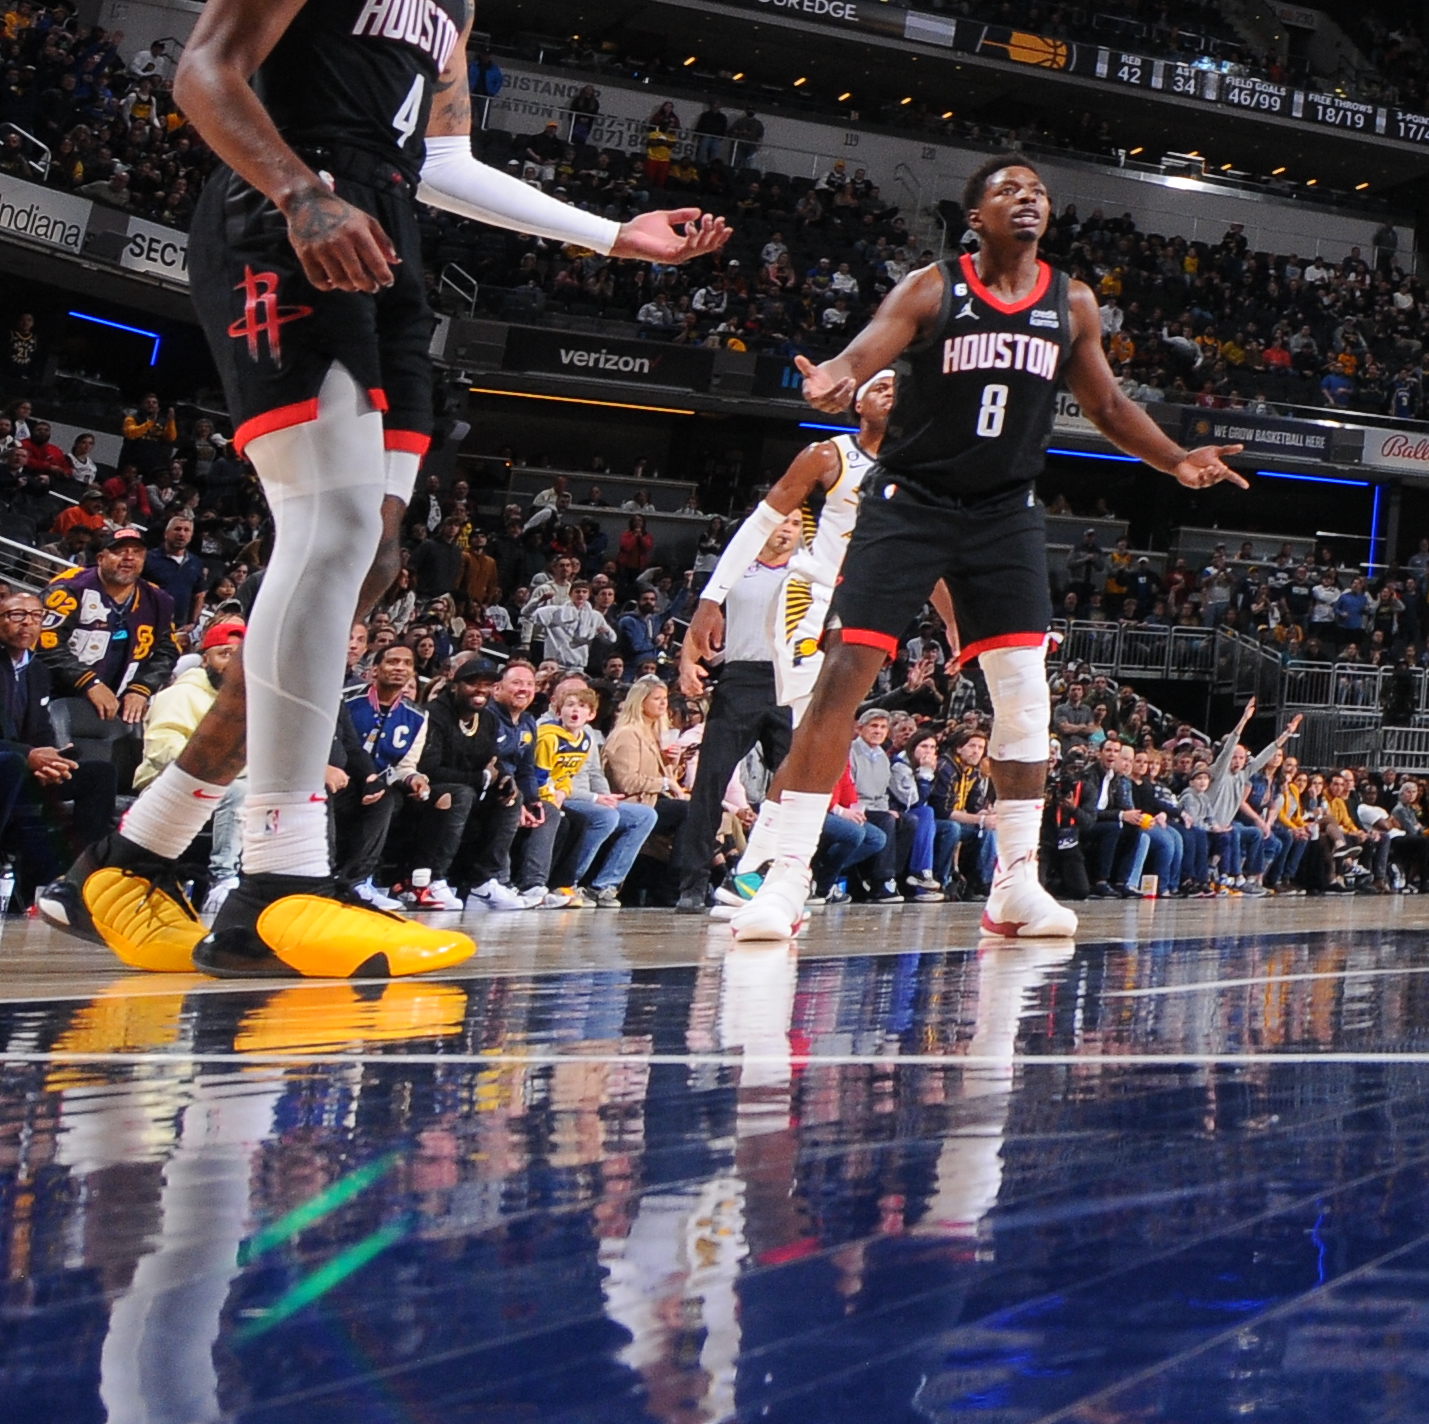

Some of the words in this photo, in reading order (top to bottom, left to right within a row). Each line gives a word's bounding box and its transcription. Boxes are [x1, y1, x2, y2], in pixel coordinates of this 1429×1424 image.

[1118, 66, 1142, 84] 42
[1175, 66, 1195, 77] AST
[1173, 76, 1196, 95] 34
[1226, 76, 1252, 89] FIELD
[1254, 83, 1286, 96] GOALS
[392, 73, 425, 149] 4
[1228, 88, 1281, 111] 46/99
[1308, 93, 1332, 106] FREE
[1334, 98, 1373, 114] THROWS
[1316, 105, 1365, 128] 18/19
[0, 196, 81, 248] ndiana
[130, 233, 188, 272] SECT
[954, 283, 968, 296] 6
[559, 347, 650, 374] verizon
[943, 333, 1059, 380] HOUSTON
[976, 384, 1009, 438] 8
[1214, 425, 1226, 438] WE
[1228, 427, 1254, 441] GROW
[1255, 430, 1304, 446] BASKETBALL
[1305, 434, 1326, 449] HERE
[46, 589, 78, 616] 02
[391, 725, 410, 749] C
